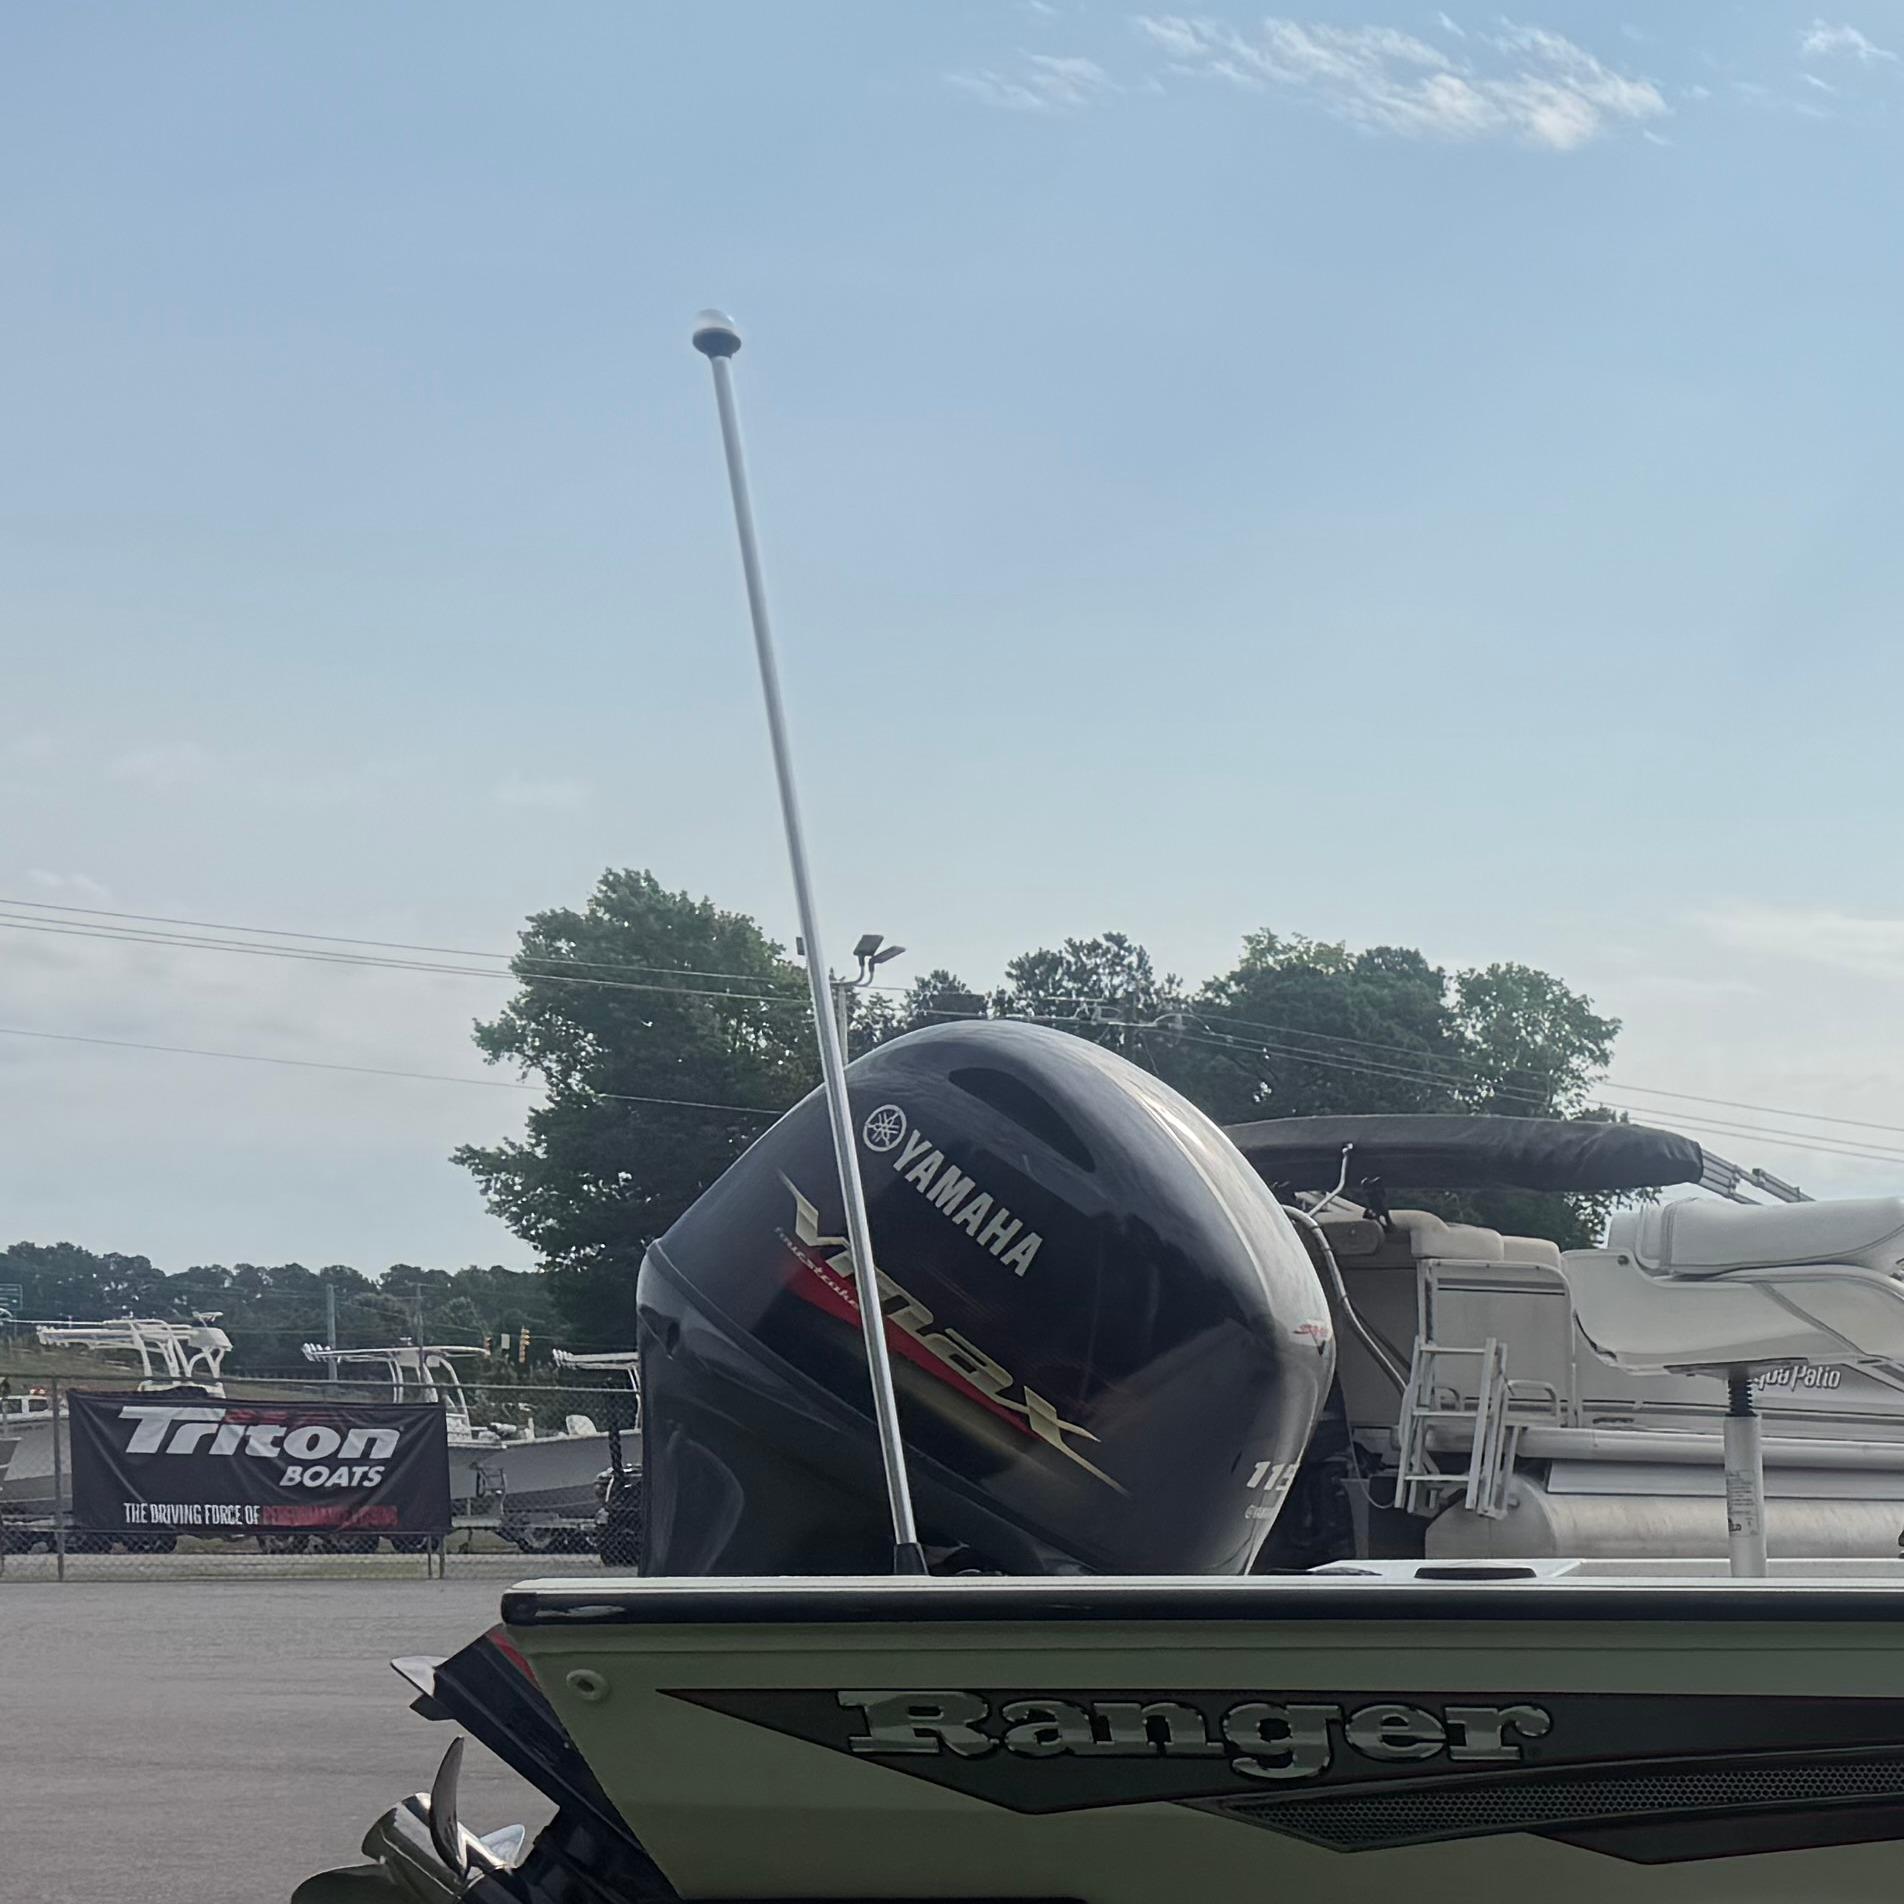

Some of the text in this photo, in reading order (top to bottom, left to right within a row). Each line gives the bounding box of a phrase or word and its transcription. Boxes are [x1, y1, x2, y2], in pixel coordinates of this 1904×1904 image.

[893, 1129, 1043, 1277] YAMAHA
[118, 1405, 401, 1460] Triton
[279, 1465, 385, 1488] BOATS
[123, 1502, 148, 1523] THE
[150, 1503, 202, 1525] DRIVING
[204, 1503, 243, 1525] FORCE
[244, 1504, 260, 1525] OF
[836, 1690, 1553, 1780] Ranger
